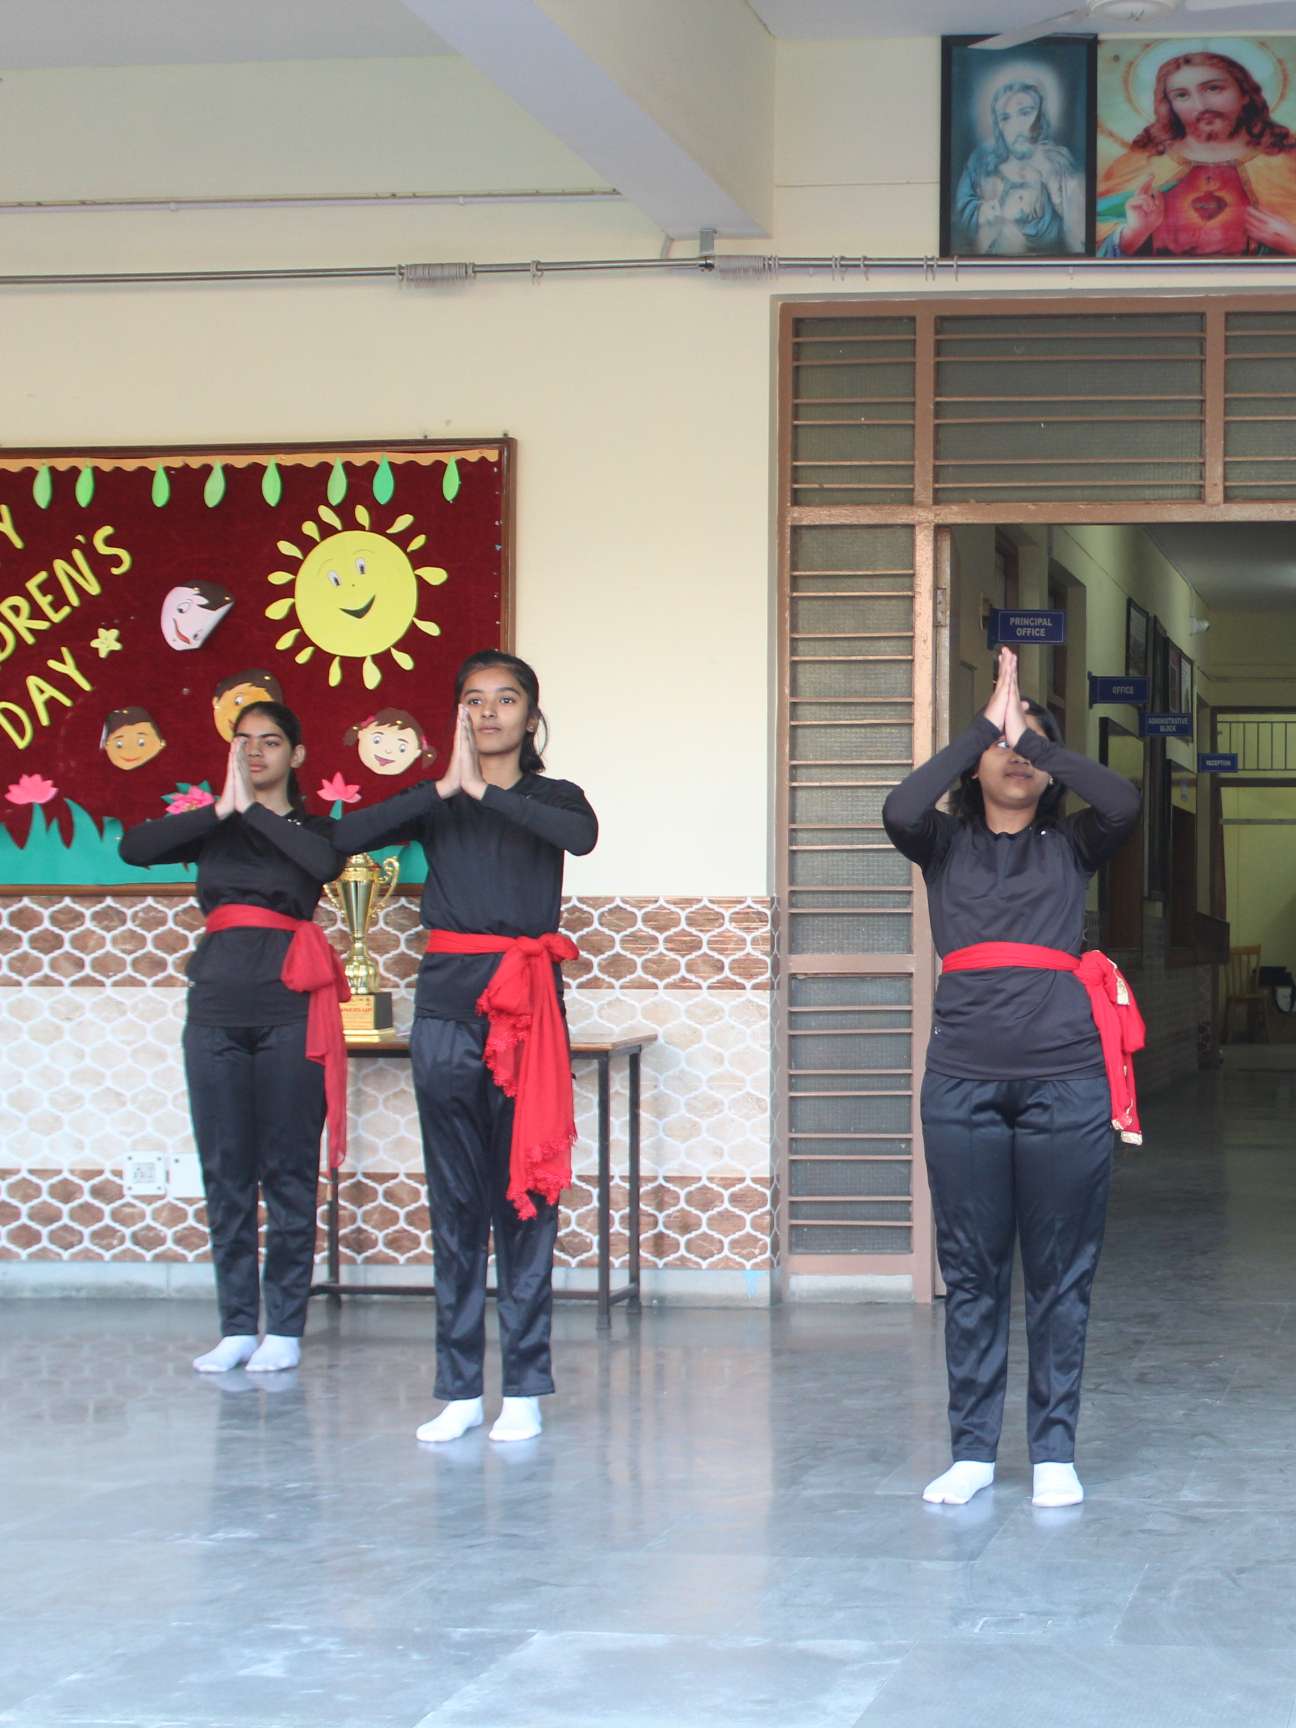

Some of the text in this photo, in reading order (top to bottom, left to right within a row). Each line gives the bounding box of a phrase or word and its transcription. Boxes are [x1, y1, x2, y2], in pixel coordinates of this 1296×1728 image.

[1009, 616, 1053, 627] PRINCIPAL
[1016, 627, 1047, 638] OFFICE
[0, 646, 94, 750] DAY
